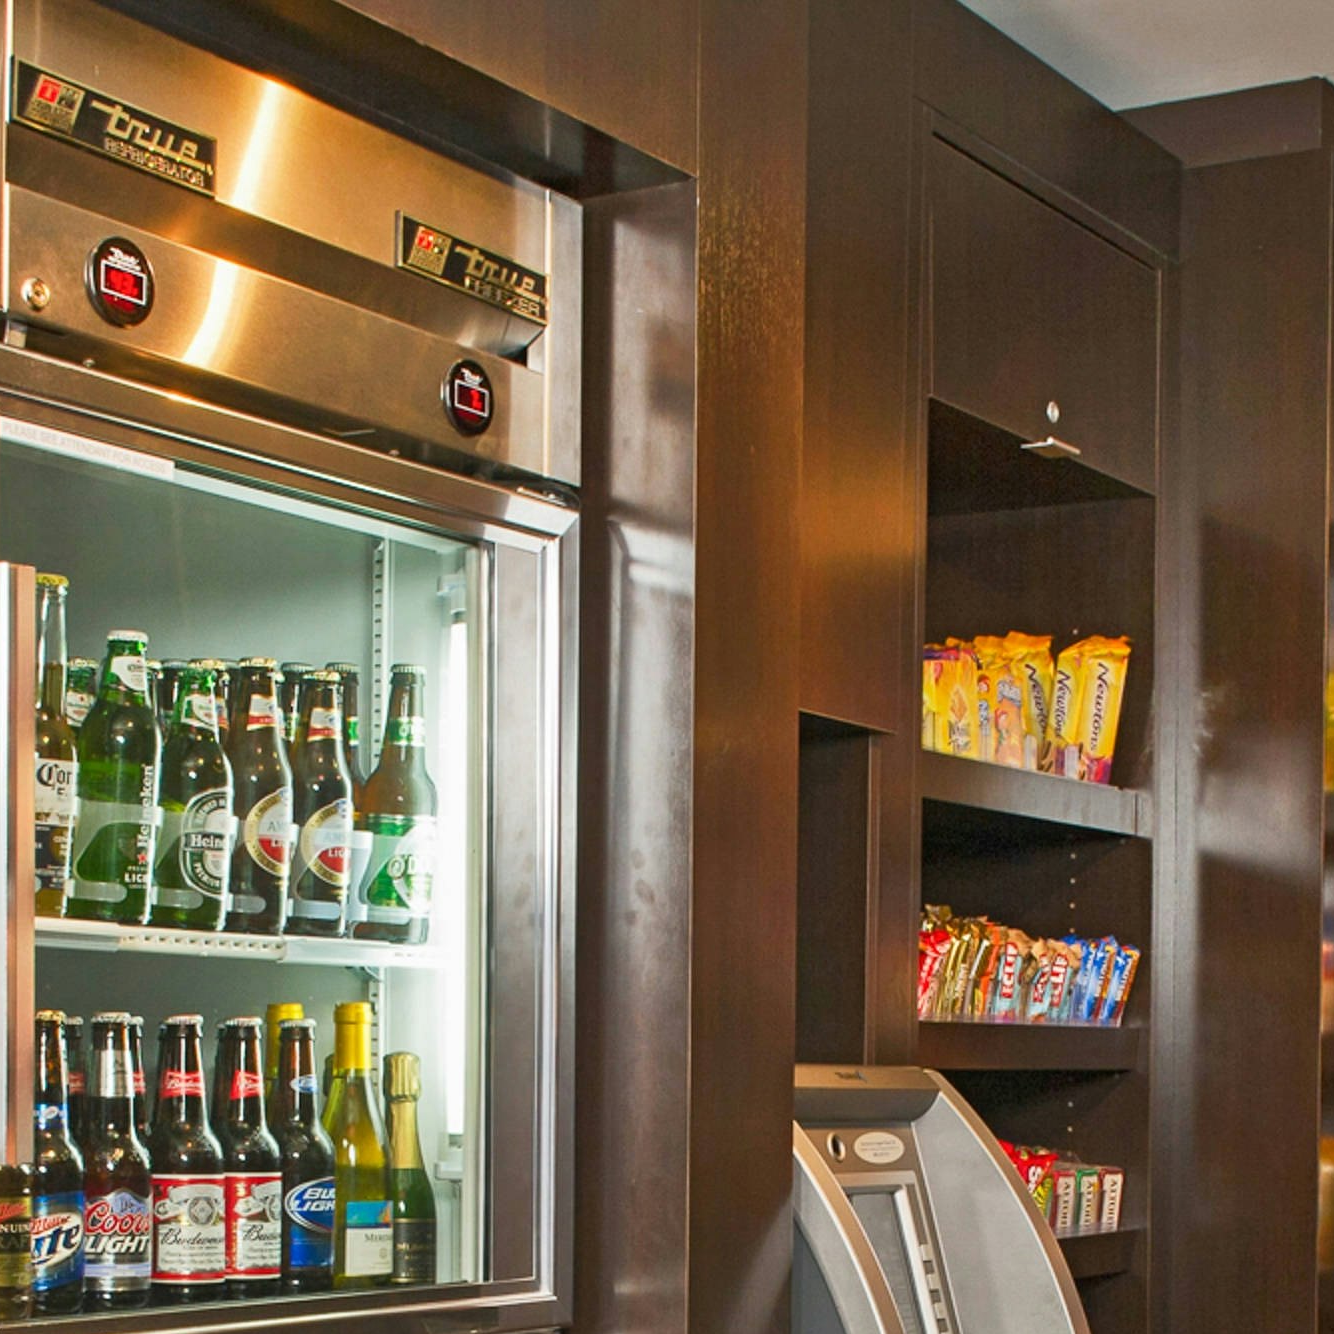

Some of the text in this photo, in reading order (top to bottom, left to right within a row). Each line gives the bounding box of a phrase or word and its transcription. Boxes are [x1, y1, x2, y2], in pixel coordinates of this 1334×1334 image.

[1090, 662, 1110, 751] Newtons
[36, 762, 72, 788] Cor
[291, 1200, 336, 1212] LIGH
[84, 1235, 150, 1254] LIGHT
